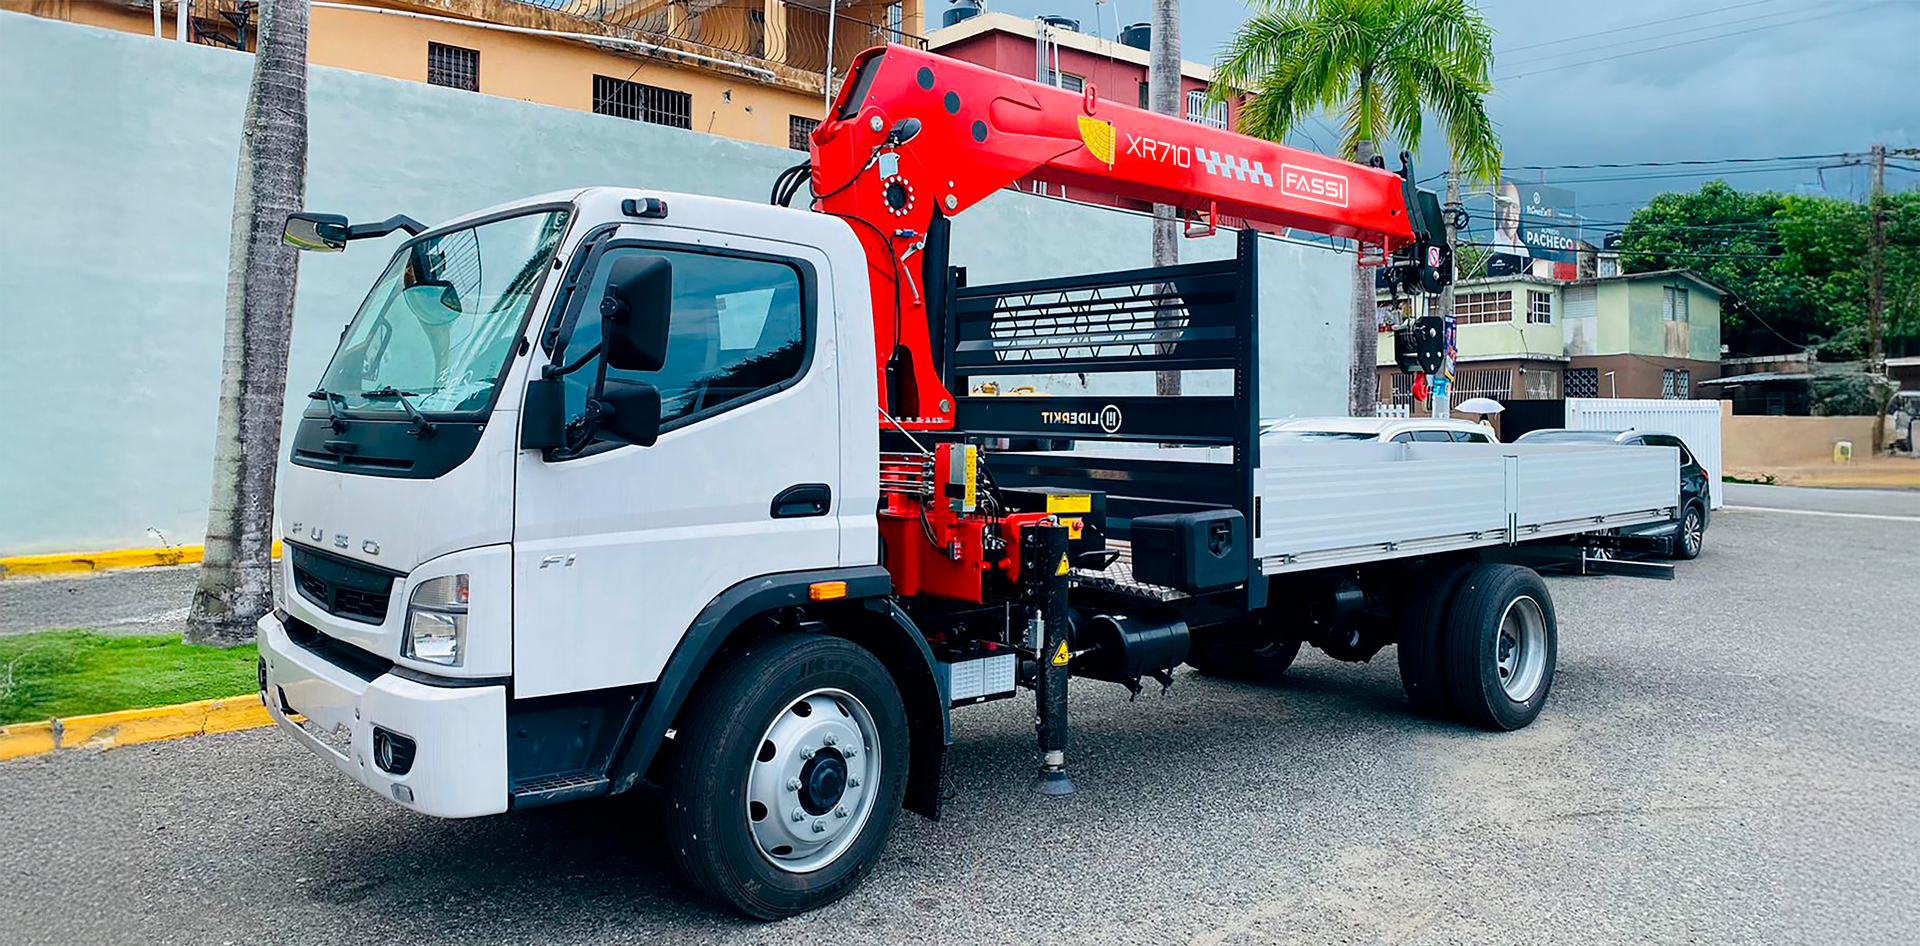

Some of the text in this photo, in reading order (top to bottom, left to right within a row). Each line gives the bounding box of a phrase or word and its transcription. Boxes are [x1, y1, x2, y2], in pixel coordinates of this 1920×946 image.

[1126, 133, 1191, 168] XR710
[1286, 171, 1344, 199] FASSI
[1526, 230, 1574, 250] PACHECO
[292, 522, 380, 556] FUSO
